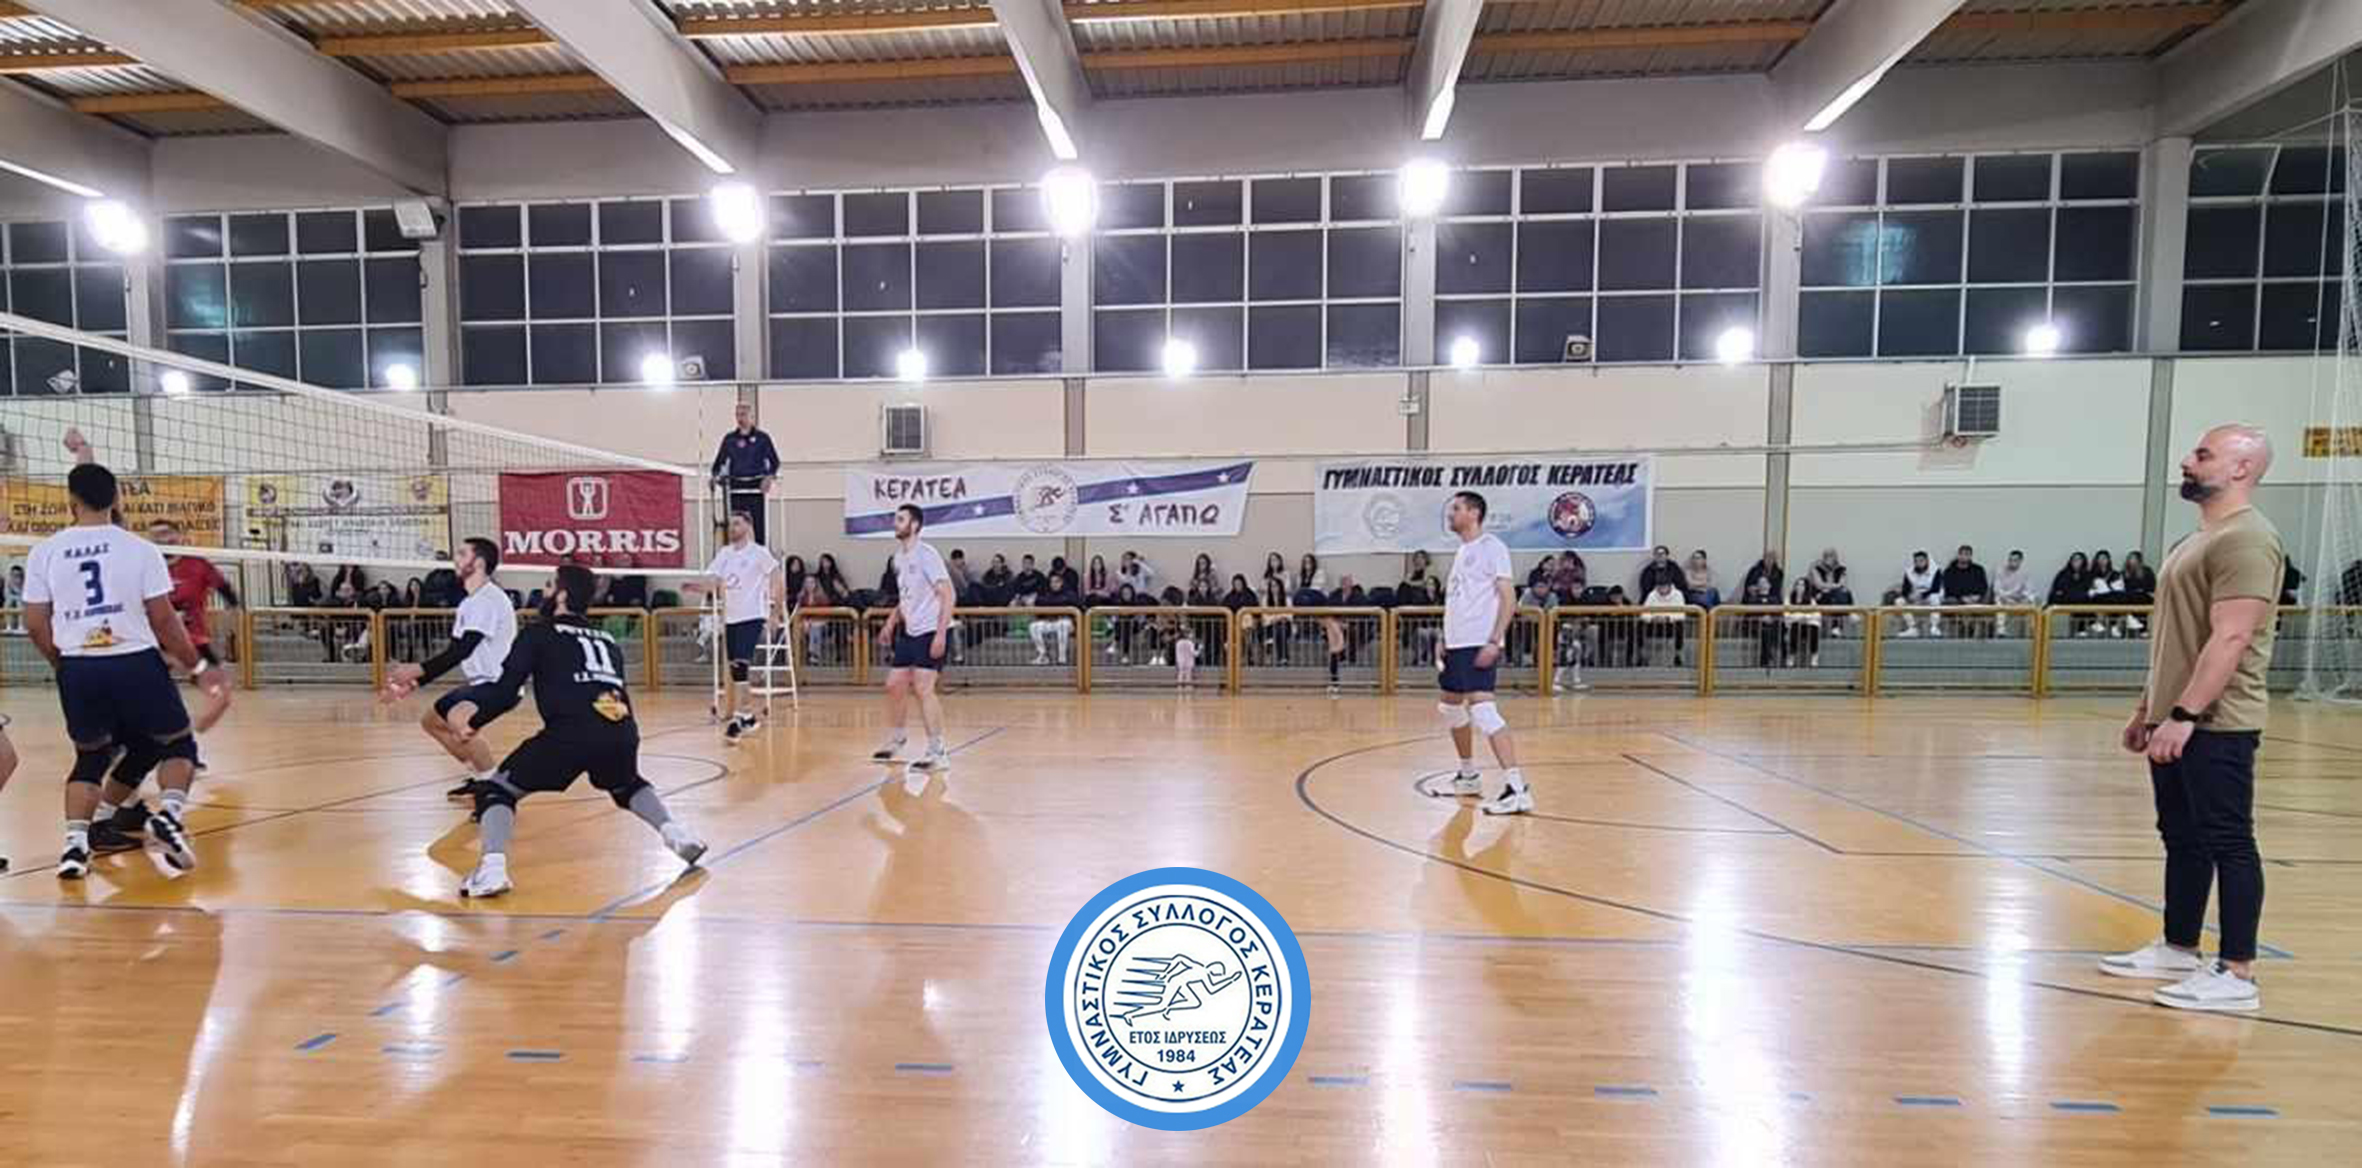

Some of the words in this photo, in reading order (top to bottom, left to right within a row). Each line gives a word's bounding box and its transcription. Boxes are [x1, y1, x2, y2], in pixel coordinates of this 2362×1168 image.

[874, 477, 966, 500] ΚΕΡΑΤΕΑ
[1323, 466, 1445, 490] ΓΥΜΝΑΣΤΙΚΟΣ
[1450, 464, 1541, 487] ΣΥΛΛΟΓΟΣ
[1547, 463, 1638, 486] ΚΕΡΑΤΕΑΣ
[1139, 503, 1219, 526] ΑΓΑΠΩ
[504, 530, 681, 554] MORRIS
[79, 561, 104, 606] 3
[577, 636, 616, 675] 11
